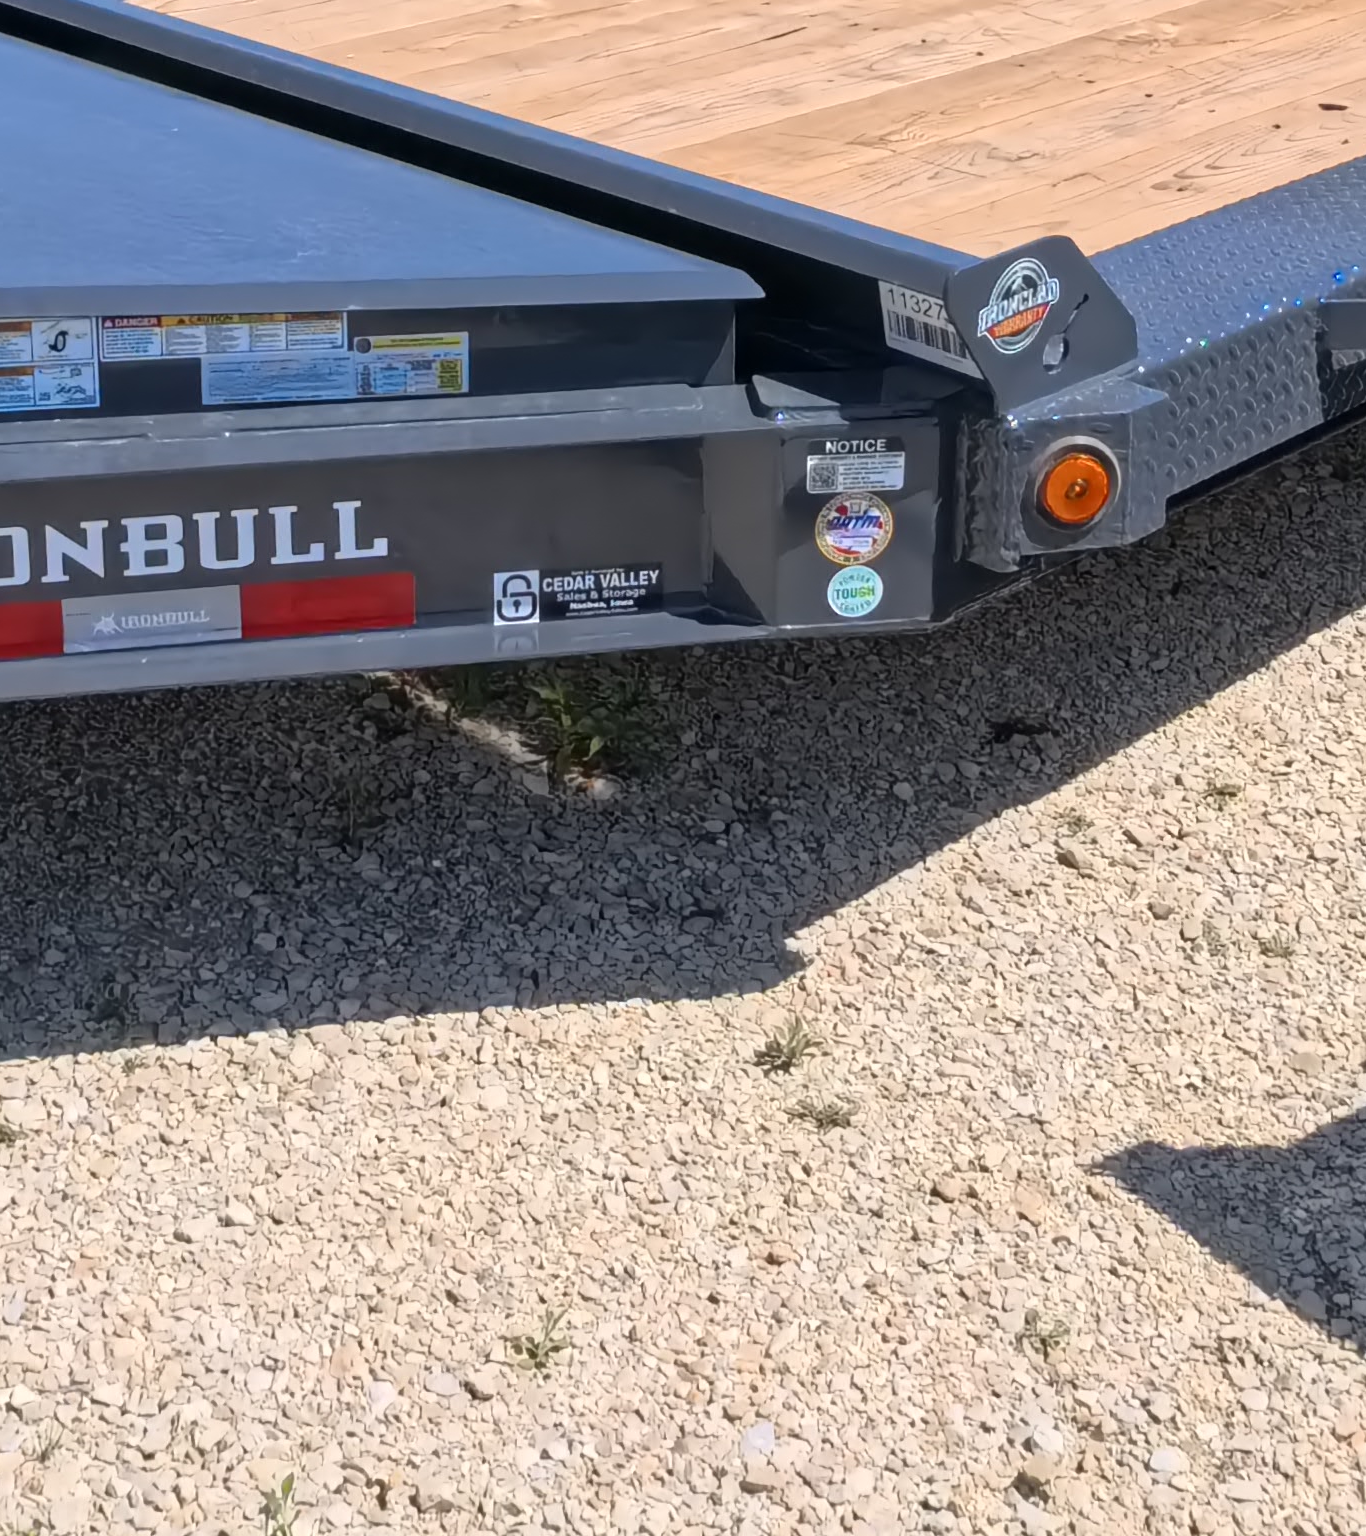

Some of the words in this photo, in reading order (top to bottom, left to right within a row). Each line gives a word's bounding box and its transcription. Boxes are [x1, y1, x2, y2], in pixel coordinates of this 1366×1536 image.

[980, 280, 1058, 333] IRONCLAD
[825, 439, 887, 454] NOTICE
[542, 574, 595, 592] CEDAR
[599, 569, 660, 588] VALLEY
[556, 591, 587, 602] Sales
[602, 588, 646, 599] Storage
[834, 586, 875, 600] TOUGH
[121, 610, 210, 630] IRONBULL
